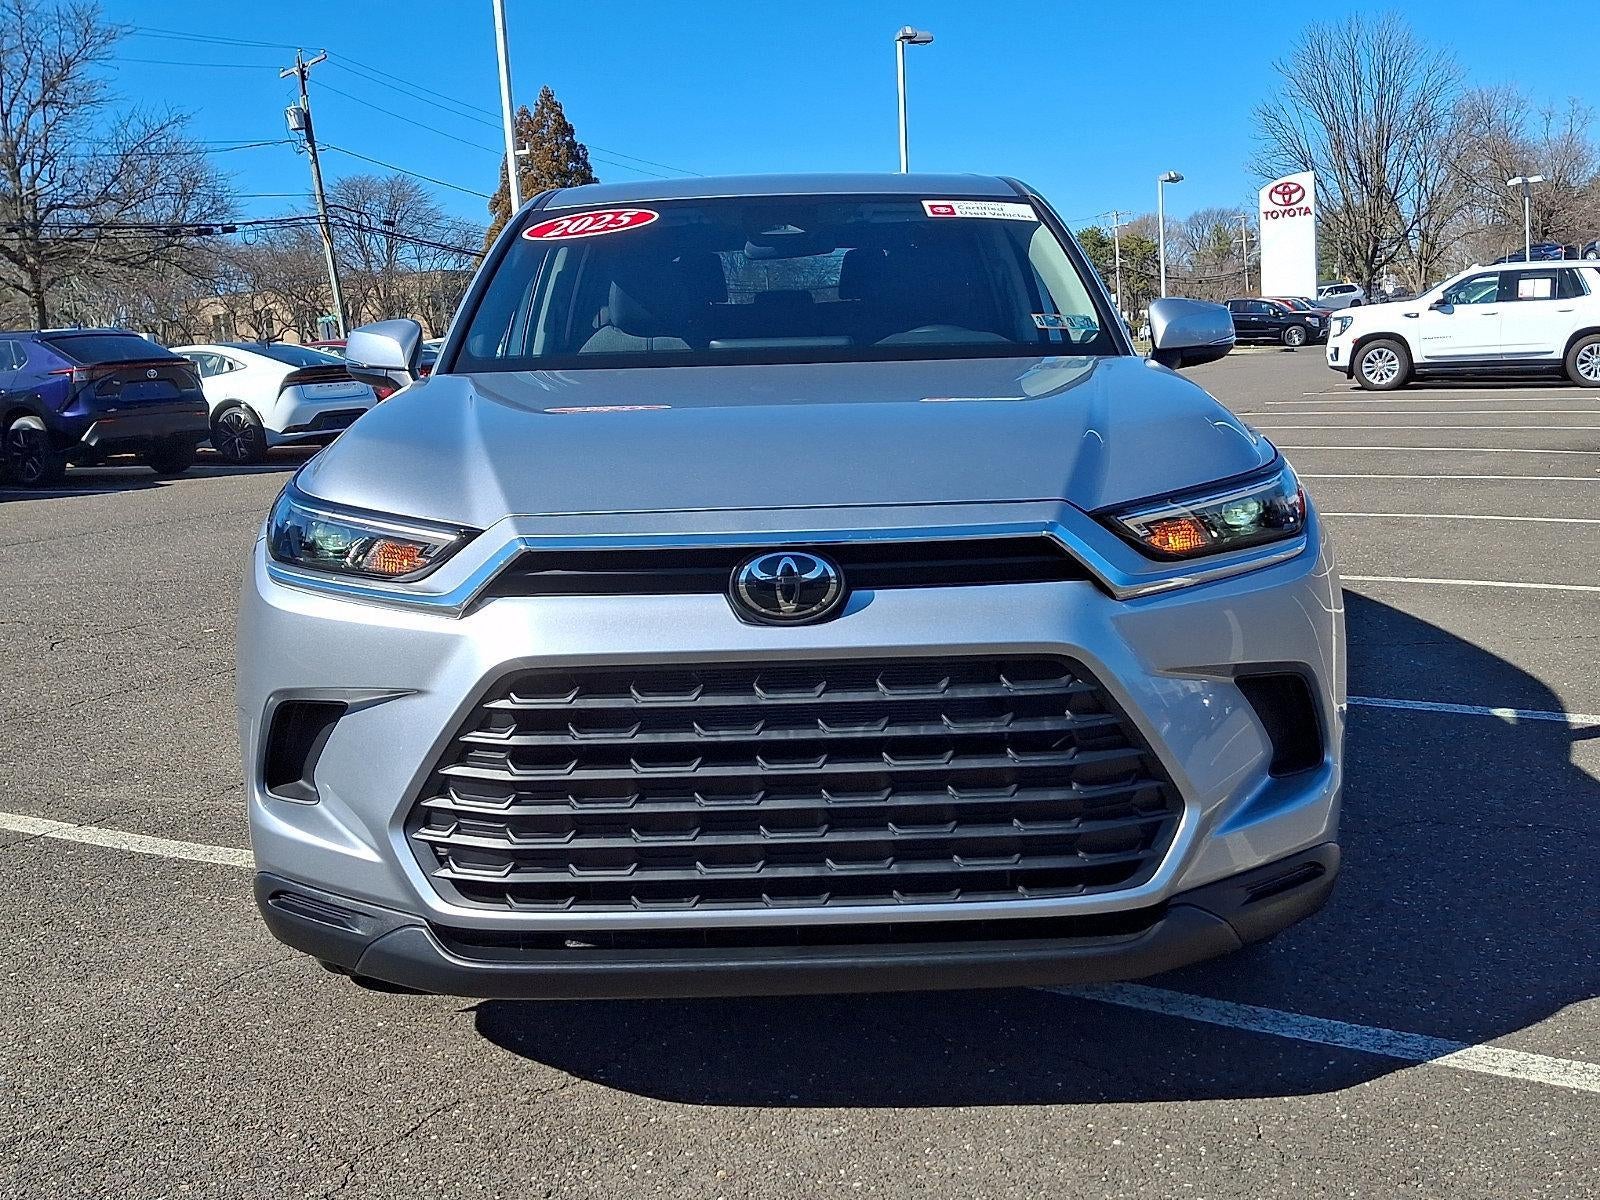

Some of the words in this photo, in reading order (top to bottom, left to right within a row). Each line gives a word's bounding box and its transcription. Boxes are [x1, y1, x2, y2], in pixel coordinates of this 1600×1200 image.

[957, 204, 1004, 212] Certified
[1263, 206, 1312, 220] TOYOTA
[989, 211, 1033, 219] Vehicles
[542, 210, 639, 238] 2025
